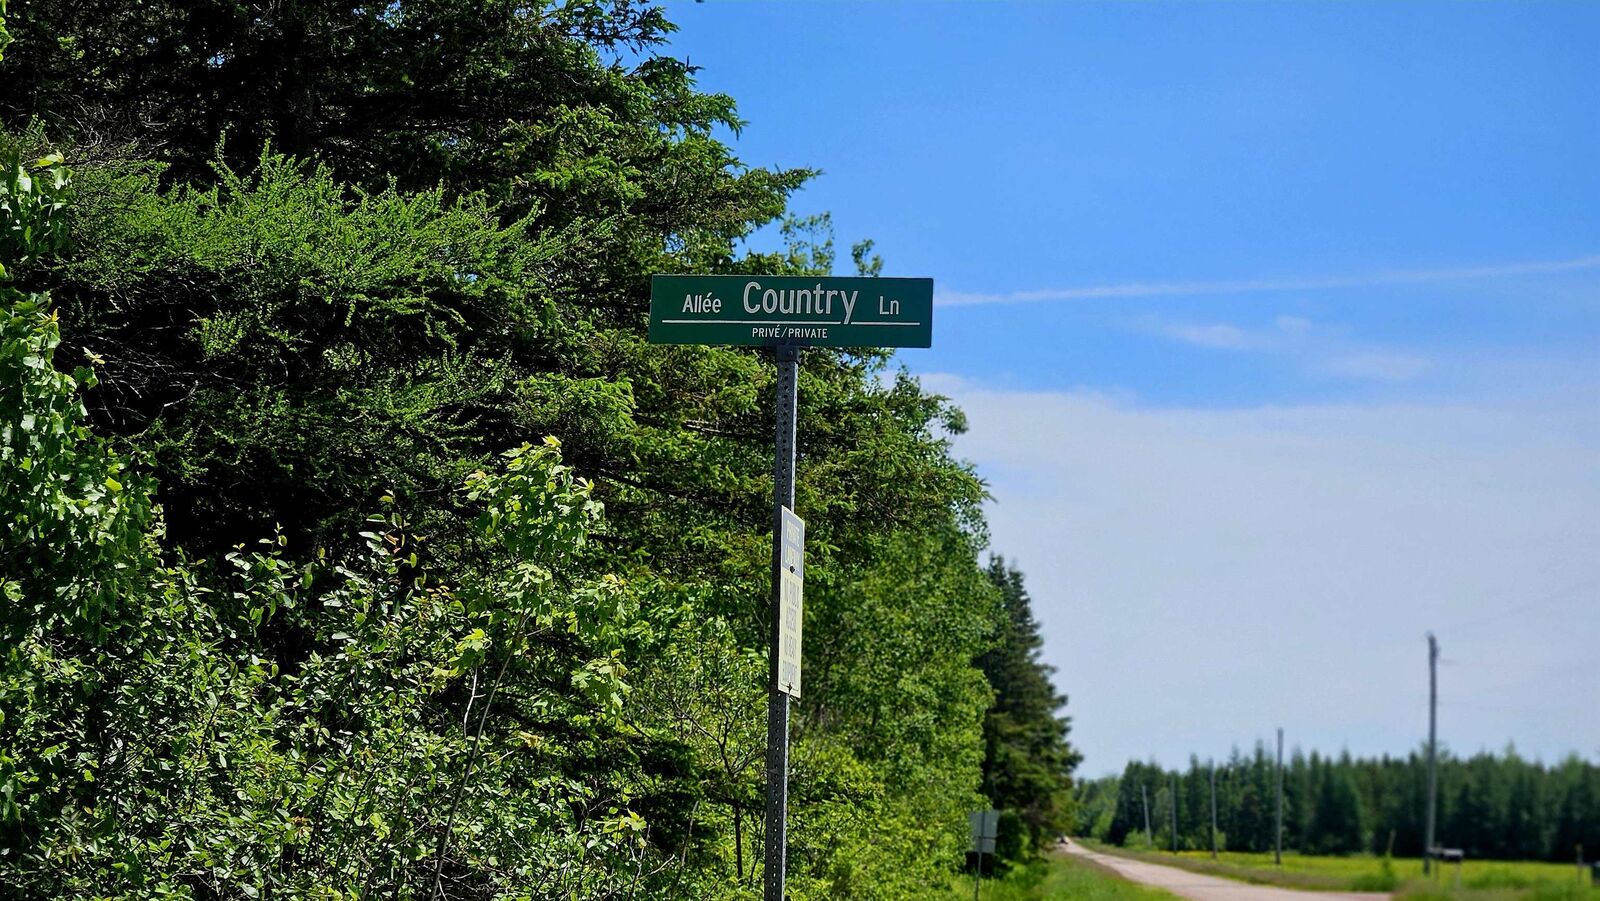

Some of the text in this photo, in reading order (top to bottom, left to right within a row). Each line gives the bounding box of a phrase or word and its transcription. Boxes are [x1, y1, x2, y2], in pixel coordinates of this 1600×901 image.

[682, 281, 899, 324] Allée Country Ln
[752, 325, 828, 339] PRIVÉ/PRIVATE
